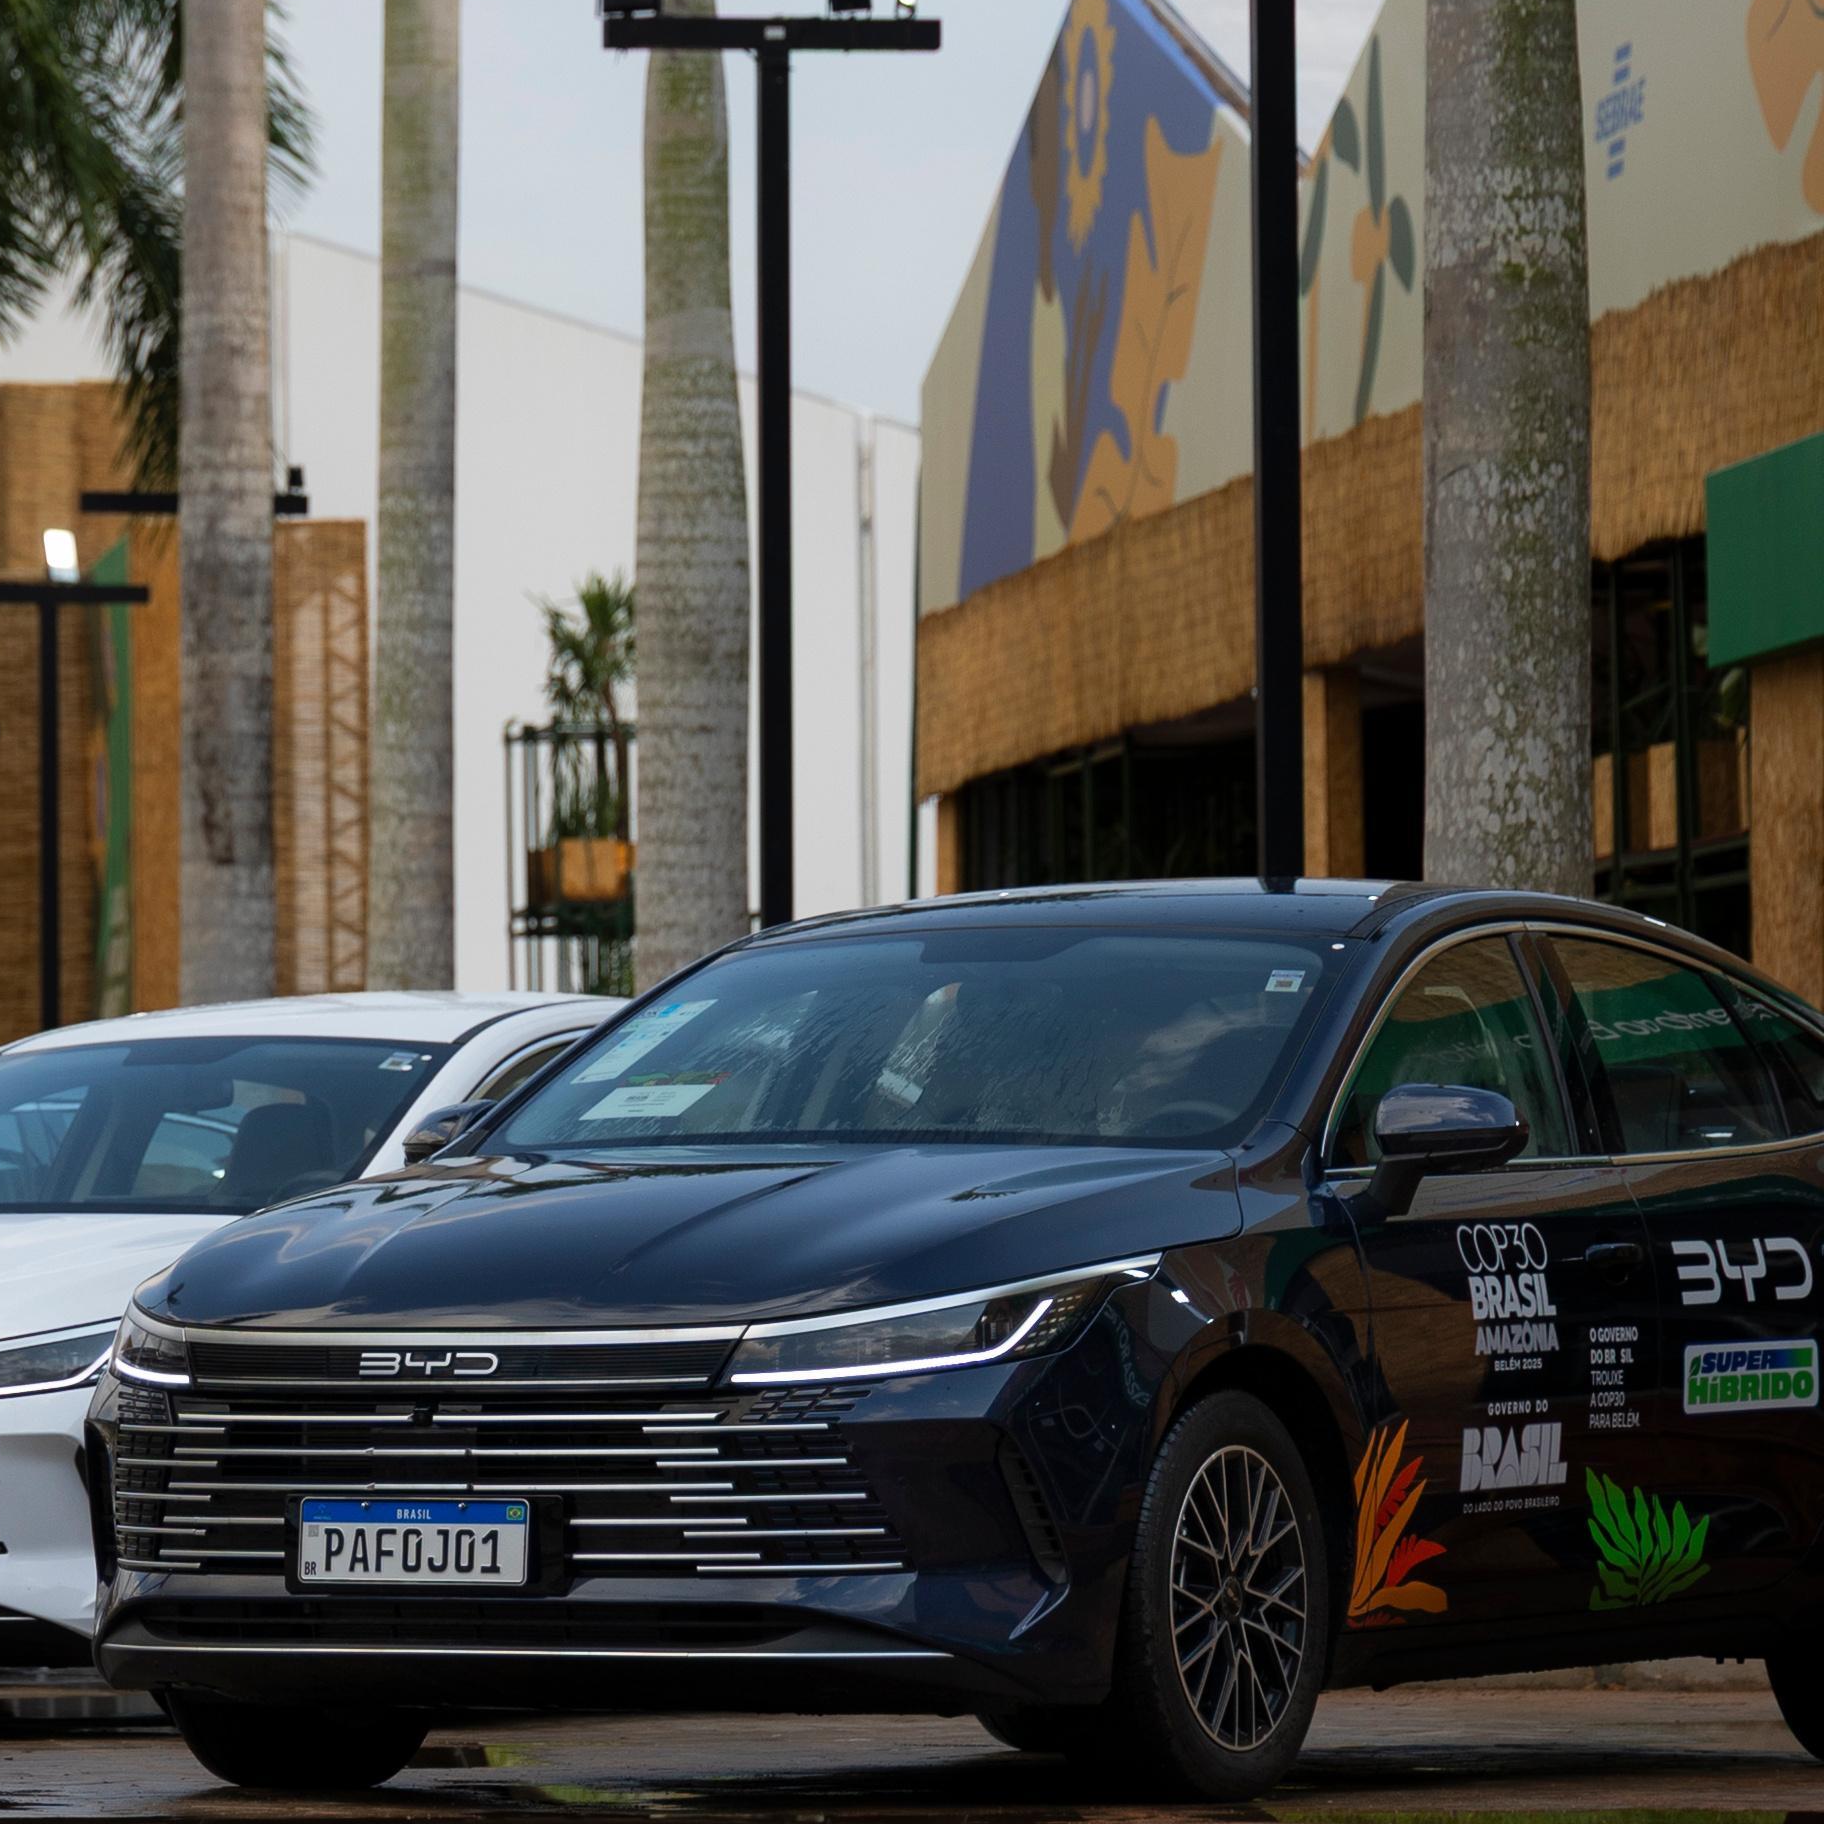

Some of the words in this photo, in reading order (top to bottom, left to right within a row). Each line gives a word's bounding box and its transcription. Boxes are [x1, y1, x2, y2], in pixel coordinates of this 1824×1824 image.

[1670, 1236, 1814, 1306] BYD
[1468, 1273, 1558, 1320] BRASIL
[1474, 1320, 1560, 1356] AMAZÔNIA
[1589, 1327, 1597, 1343] O
[1597, 1326, 1639, 1342] GOVERNO
[359, 1352, 499, 1375] BYD
[1494, 1356, 1521, 1372] BELÉM
[1522, 1357, 1543, 1370] 2025
[1590, 1349, 1603, 1364] DO
[1700, 1348, 1776, 1375] SUPER
[1590, 1369, 1624, 1386] TROUXE
[1487, 1399, 1532, 1416] GOVERNO
[1535, 1399, 1549, 1413] DO
[1589, 1413, 1611, 1429] PARA
[1459, 1421, 1569, 1493] BRASIL
[396, 1508, 431, 1520] BRASIL
[324, 1527, 501, 1574] PAF0J01
[304, 1560, 317, 1576] BR
